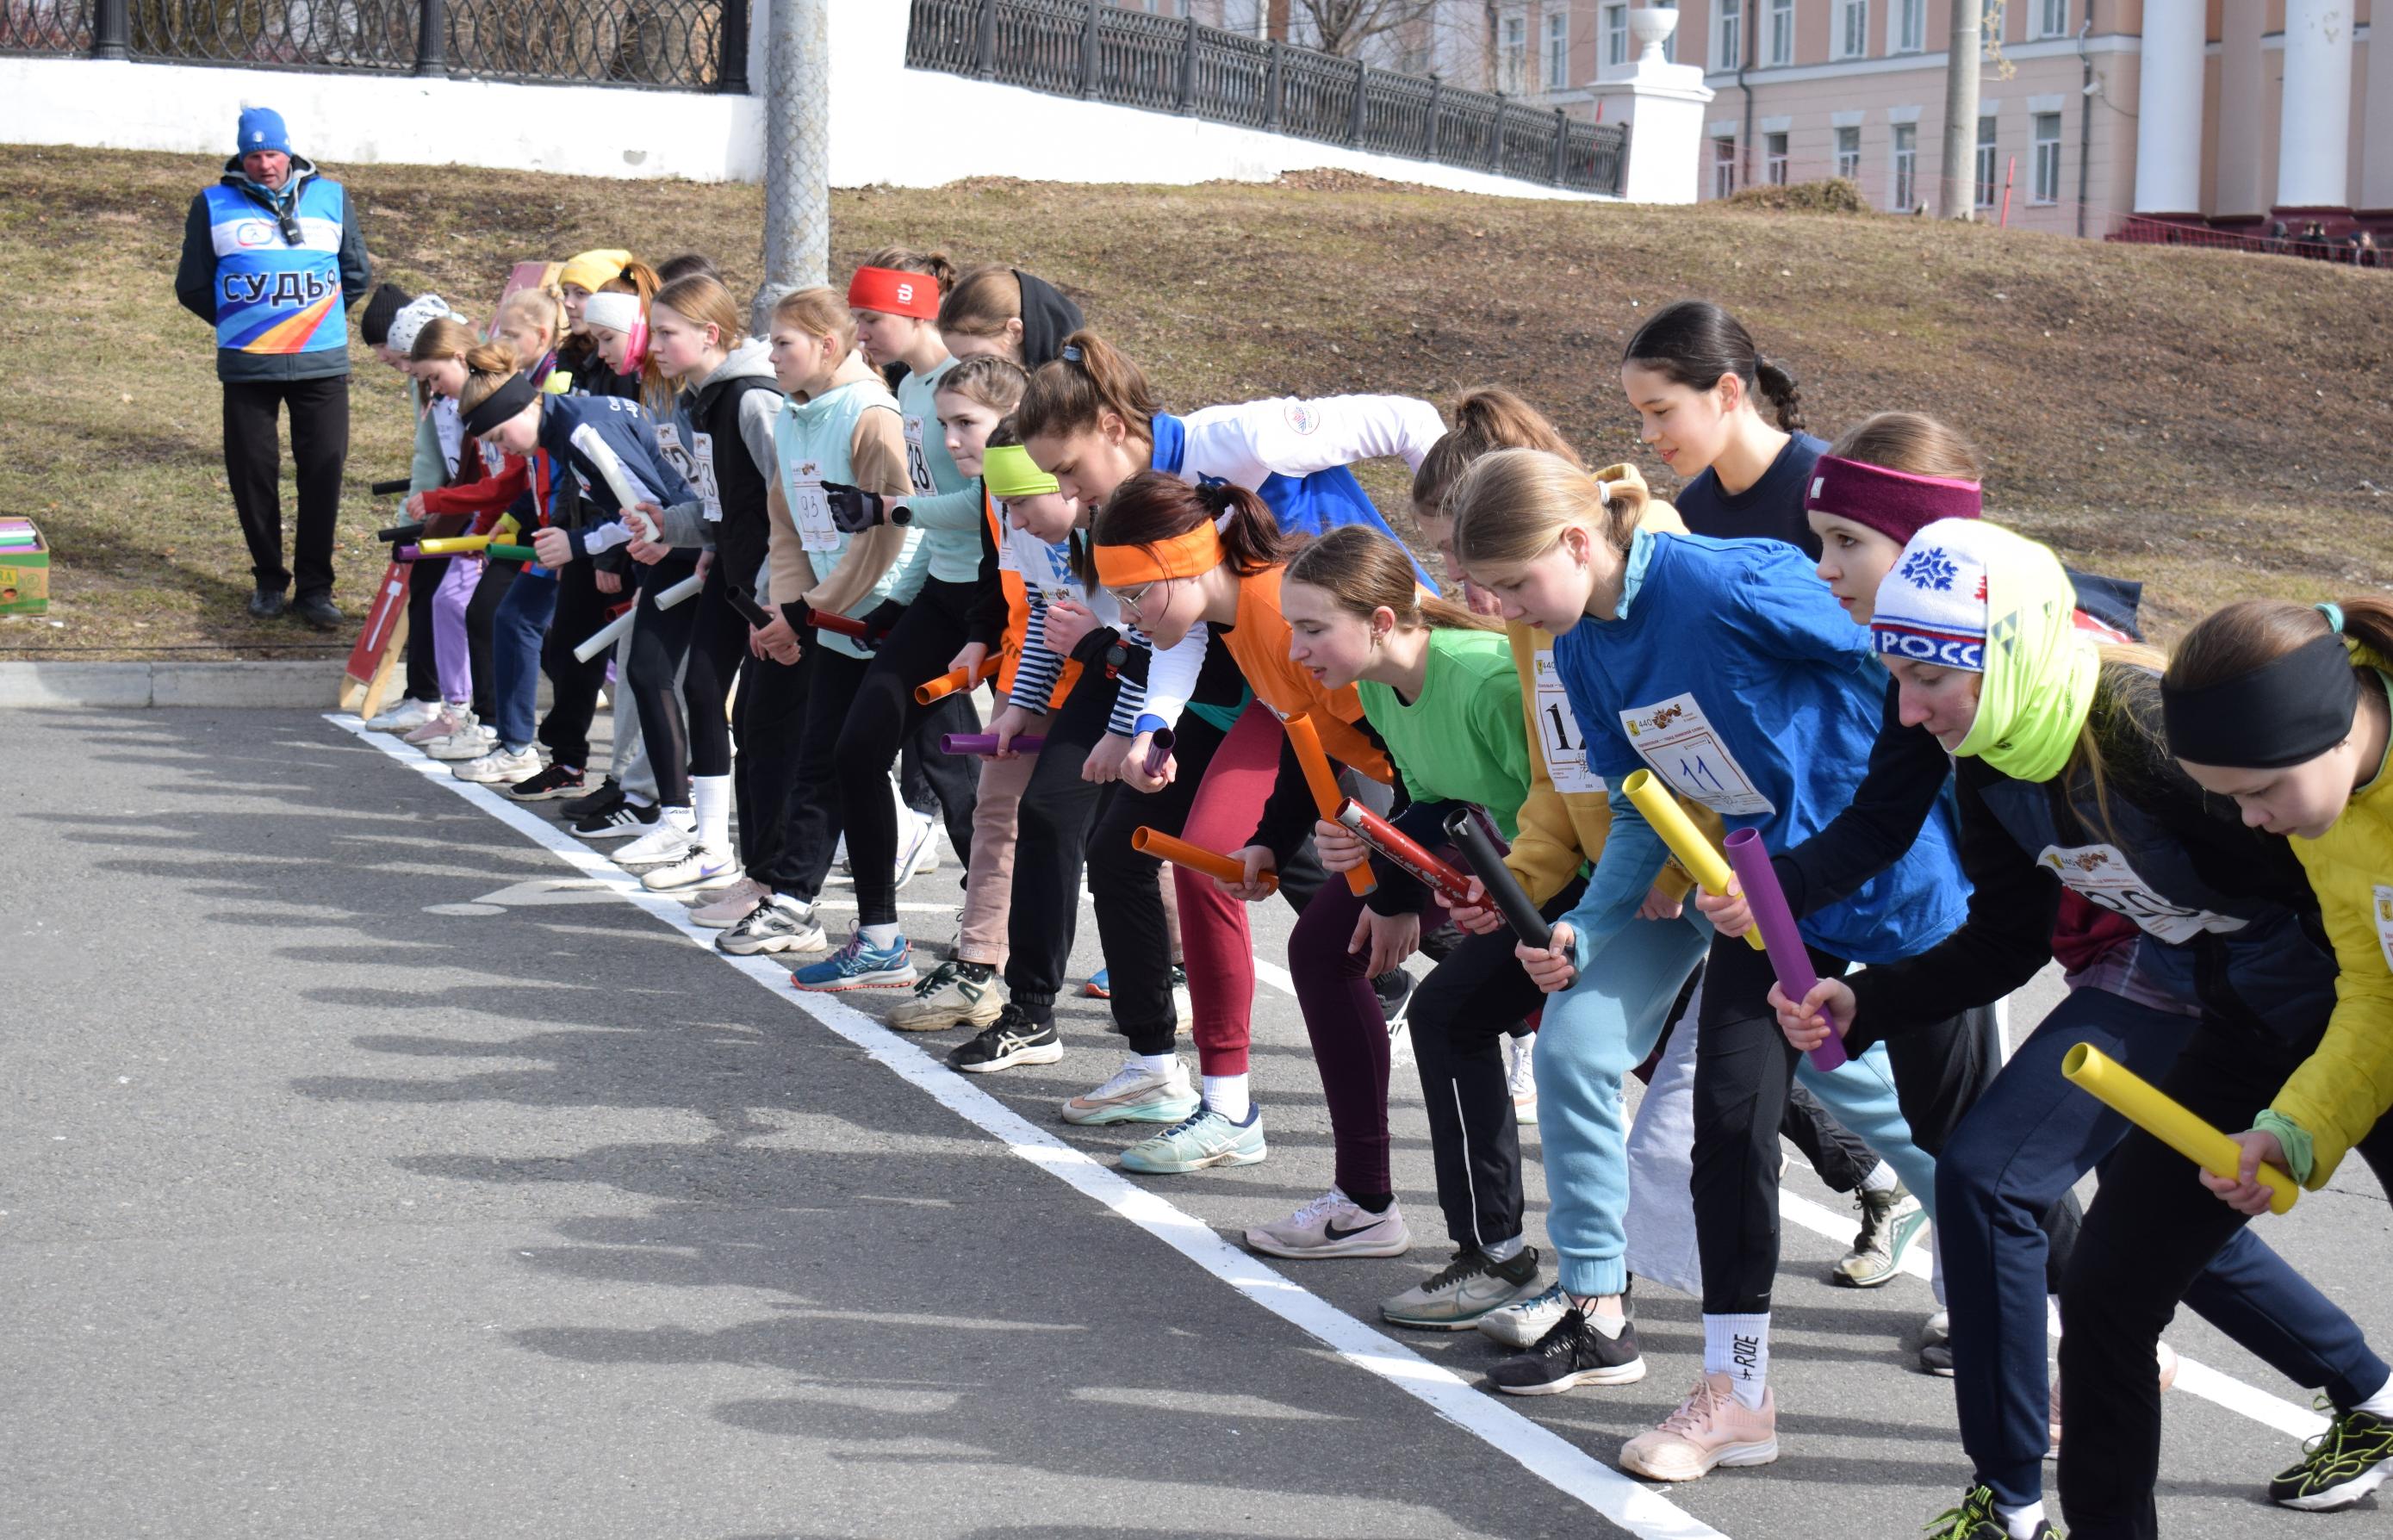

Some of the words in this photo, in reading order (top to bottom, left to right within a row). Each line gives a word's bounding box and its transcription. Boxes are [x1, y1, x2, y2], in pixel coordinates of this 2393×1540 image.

[223, 269, 337, 308] СУДЬЯ
[800, 495, 819, 519] 93
[1882, 631, 1985, 668] РОСС
[1638, 717, 1653, 728] 440
[1680, 754, 1725, 791] 11
[1732, 1333, 1759, 1369] RIDE
